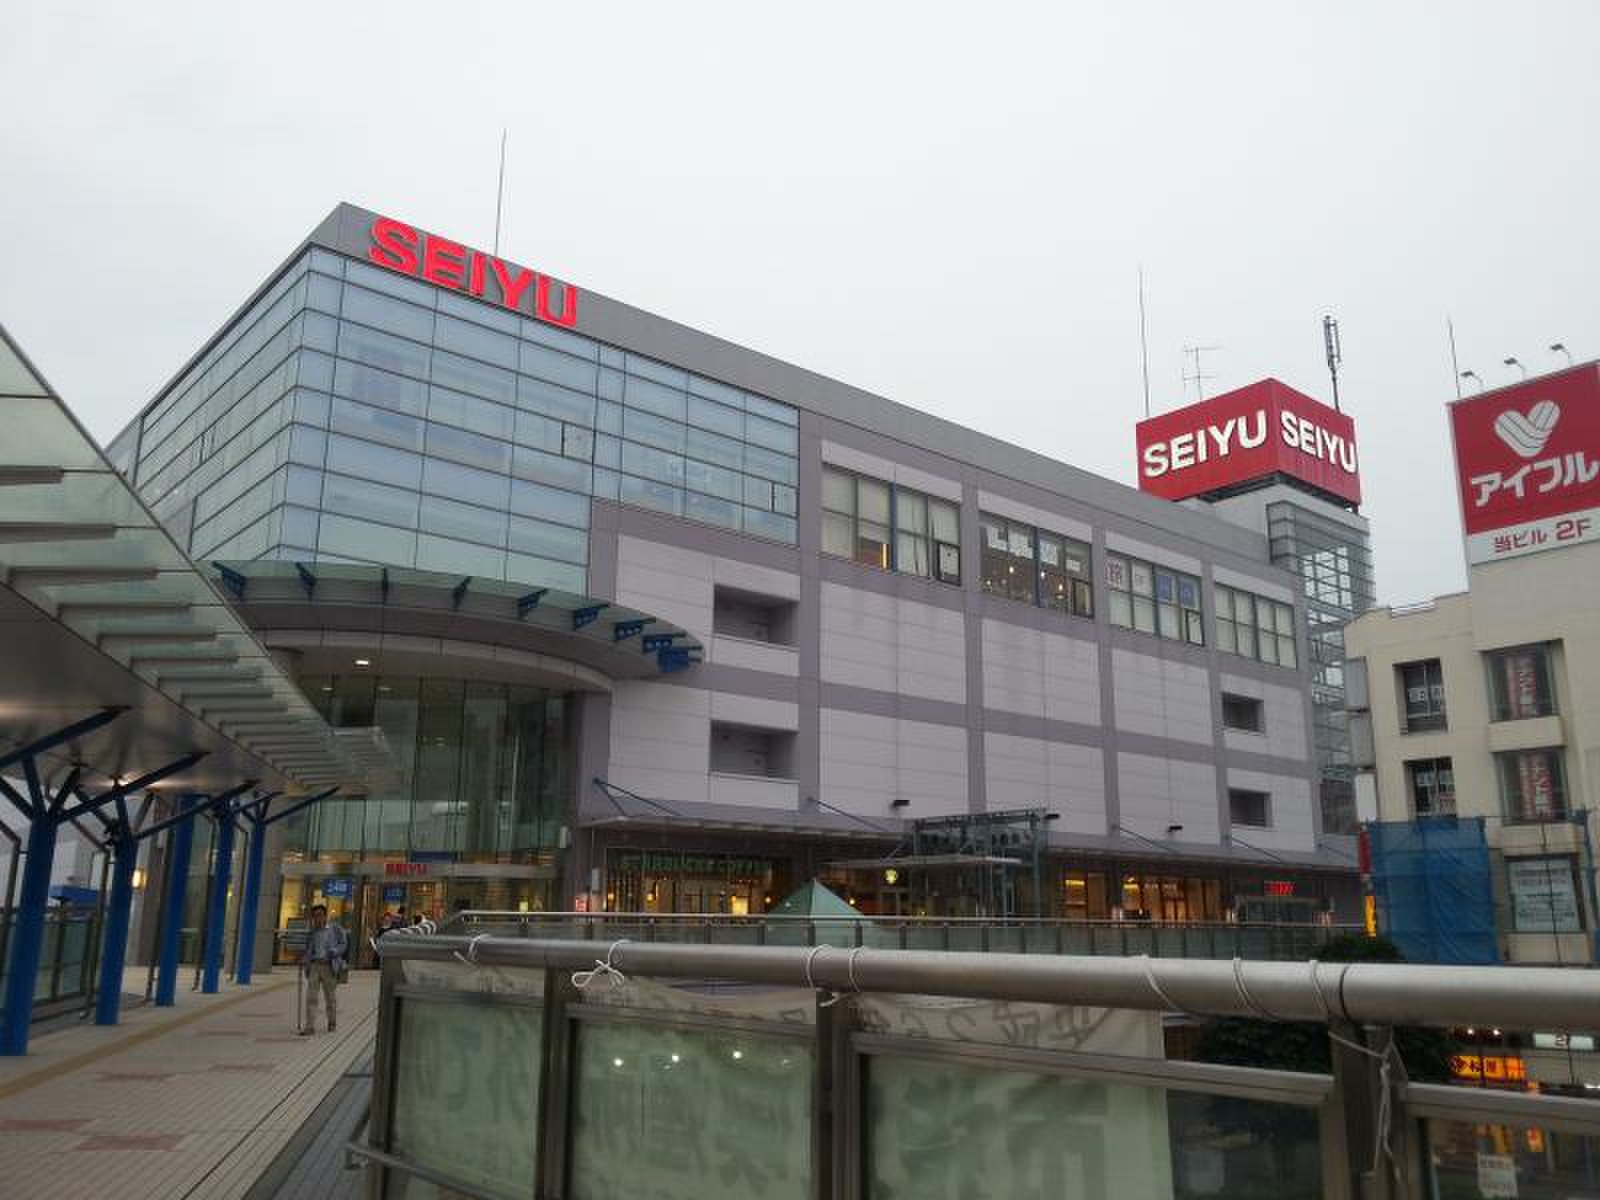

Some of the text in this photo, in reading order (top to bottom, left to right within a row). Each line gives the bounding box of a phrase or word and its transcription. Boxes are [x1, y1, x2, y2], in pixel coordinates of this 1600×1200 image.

[368, 217, 577, 328] SEIYU
[1143, 409, 1267, 478] SEIYU
[1280, 410, 1358, 474] SEIYU
[1471, 451, 1600, 507] アイフル
[1494, 518, 1592, 554] 当ビル 2F
